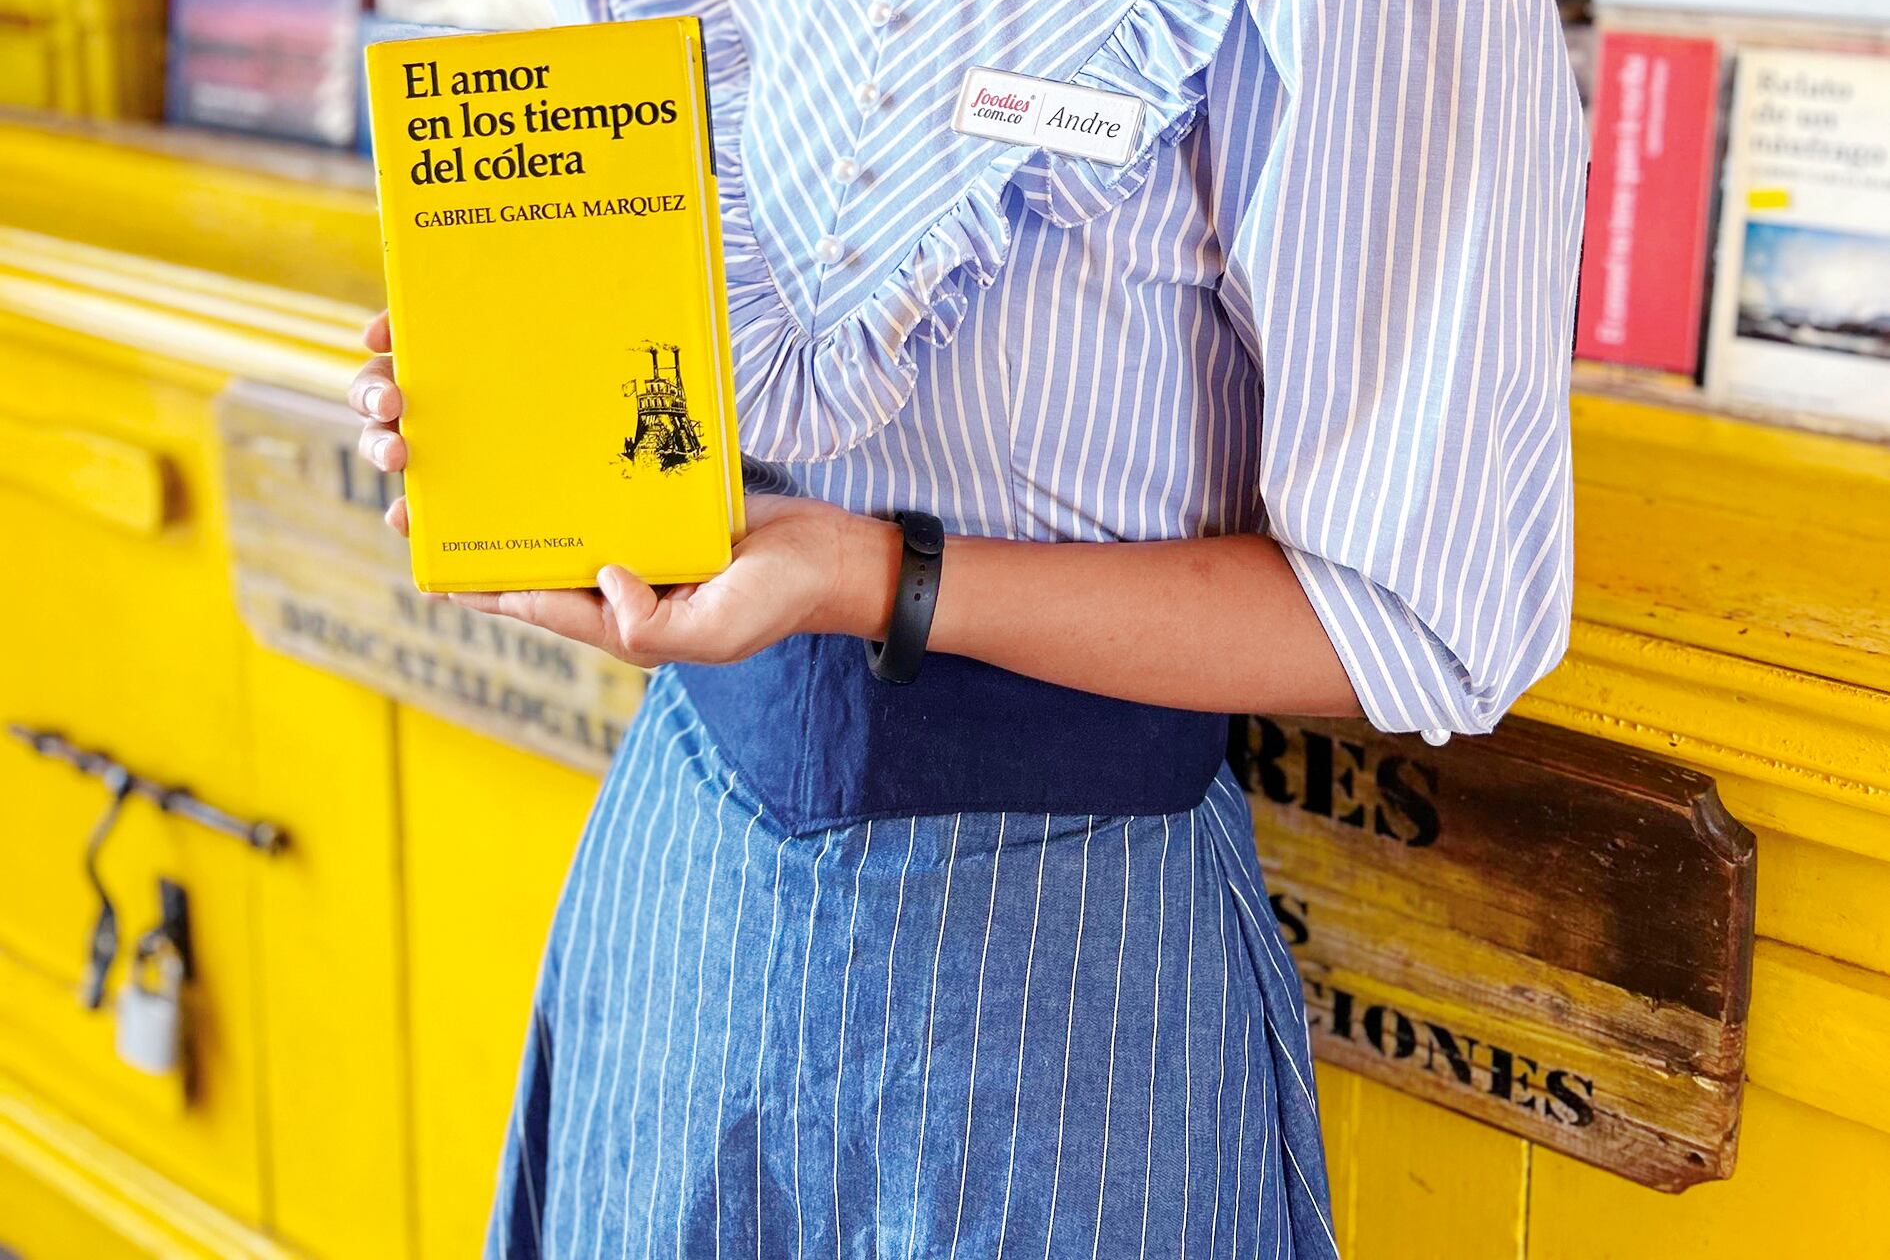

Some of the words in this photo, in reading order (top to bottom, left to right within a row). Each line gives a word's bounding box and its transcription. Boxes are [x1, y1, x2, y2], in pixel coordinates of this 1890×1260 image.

[403, 62, 441, 98] El
[451, 66, 549, 95] amor
[971, 87, 1030, 113] foodies
[973, 106, 1023, 125] .com.co
[407, 117, 452, 141] en
[460, 103, 514, 137] los
[523, 99, 677, 139] tiempos
[1046, 106, 1121, 138] Andre
[411, 147, 466, 185] del
[474, 143, 586, 183] cólera
[415, 206, 496, 228] GABRIEL
[500, 202, 576, 222] GARCIA
[583, 194, 686, 218] MARQUEZ
[442, 540, 503, 552] EDITORIAL
[506, 539, 541, 550] OVEJA
[543, 537, 584, 548] NEGRA
[1227, 713, 1439, 847] RES
